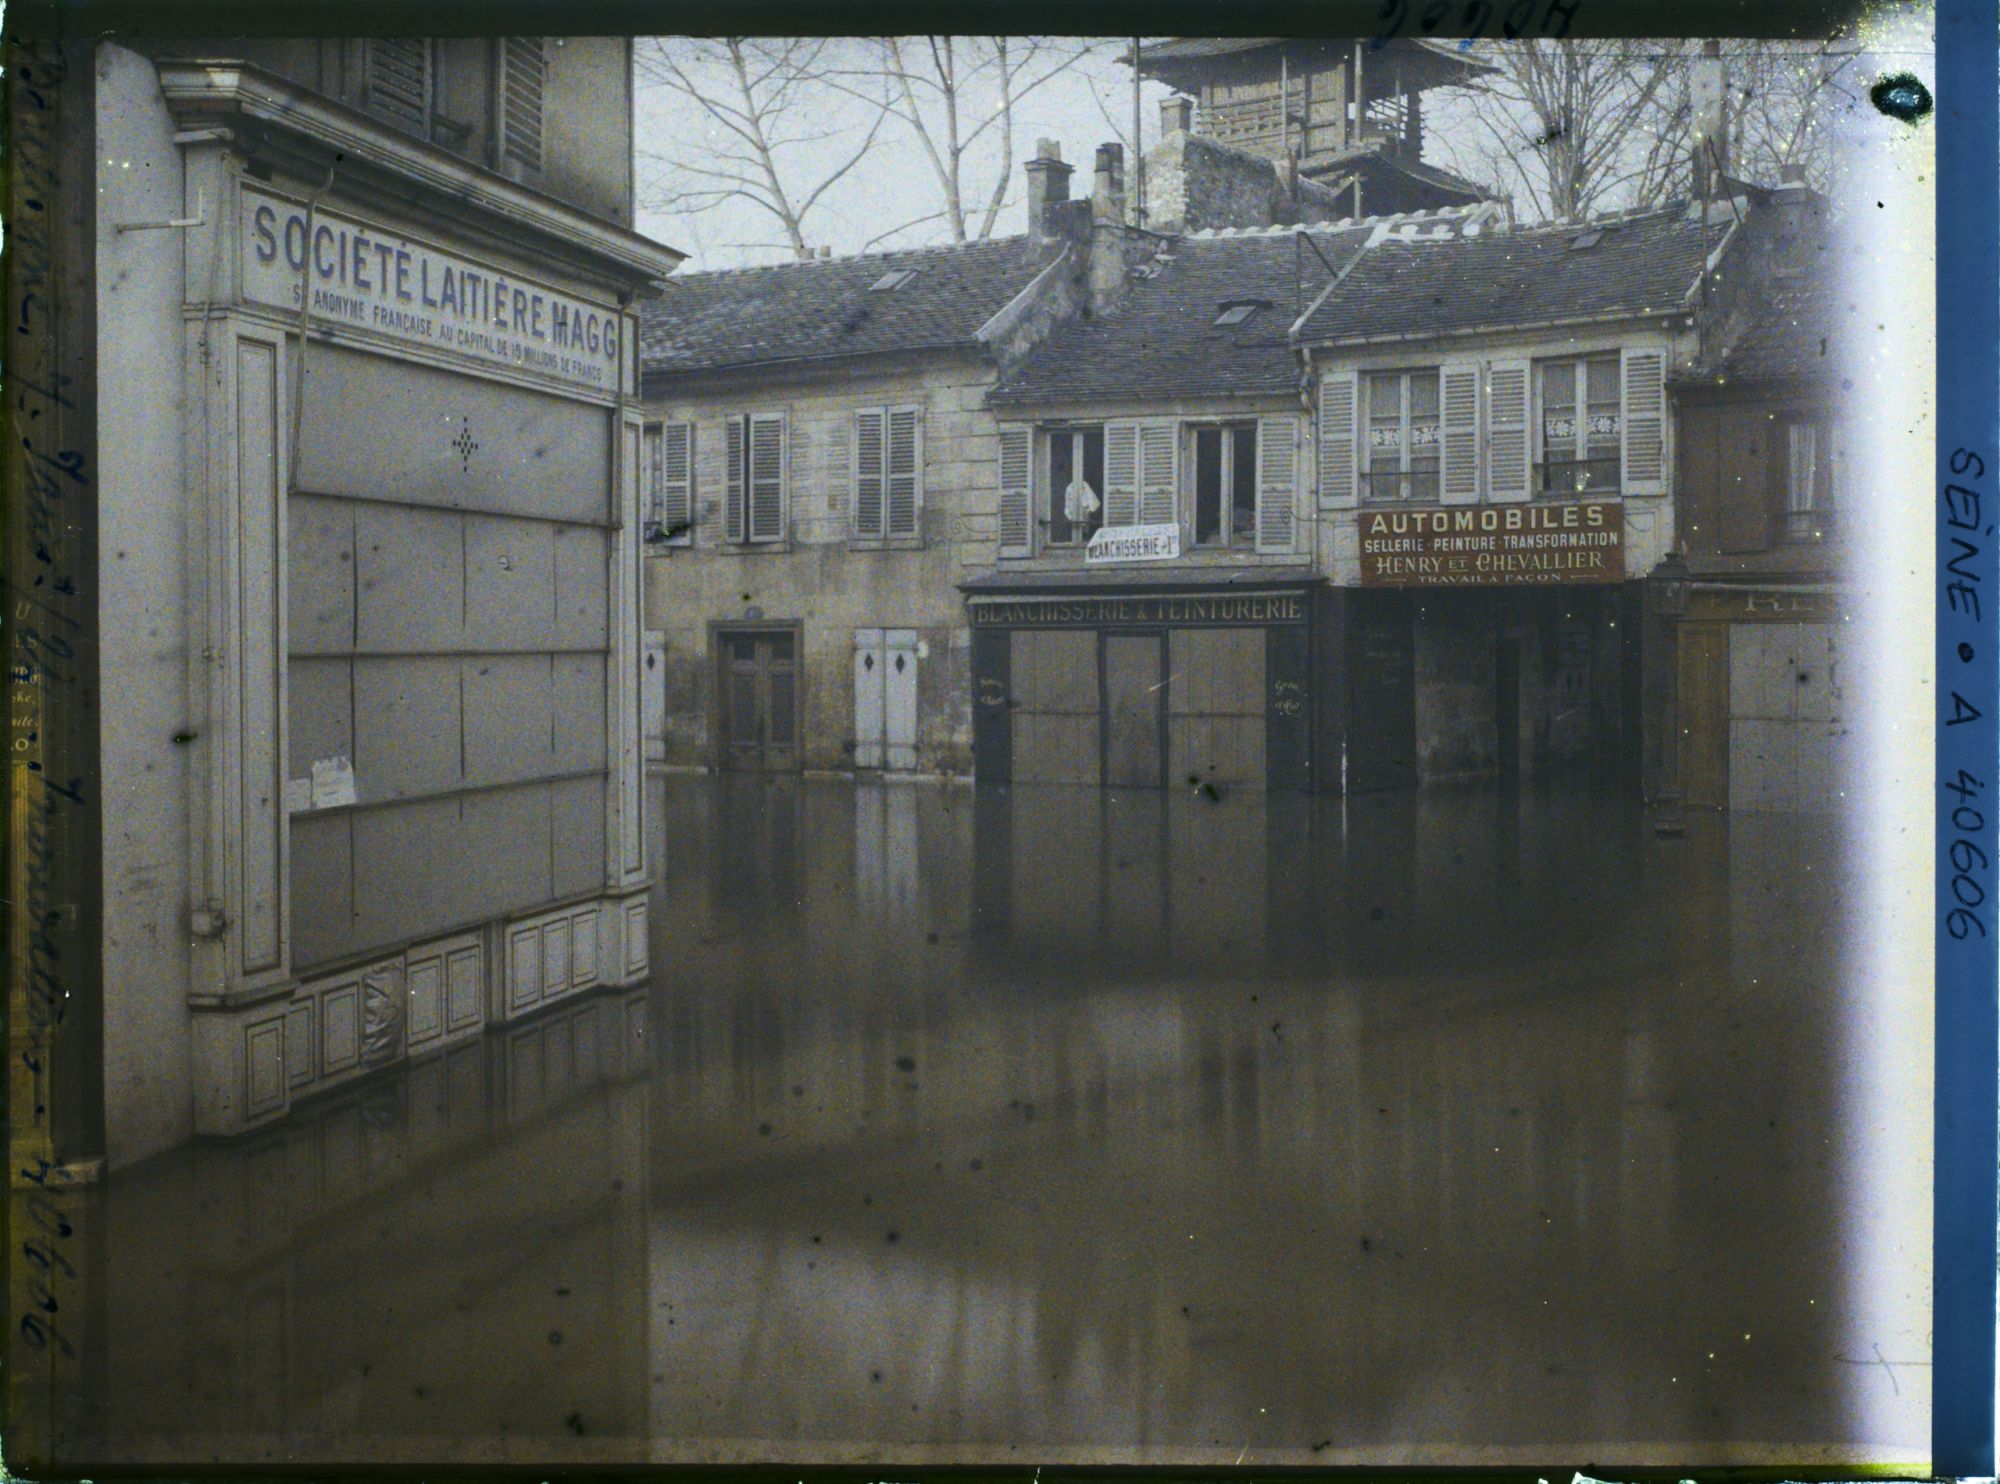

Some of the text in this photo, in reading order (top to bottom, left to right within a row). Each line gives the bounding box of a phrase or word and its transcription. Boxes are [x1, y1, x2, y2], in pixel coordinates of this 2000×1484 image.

[313, 289, 366, 321] ANONYME
[439, 323, 454, 342] AU
[457, 328, 495, 354] CAPITAL
[551, 301, 622, 361] MAGG
[1370, 506, 1604, 534] AUTOMOBILES
[1364, 532, 1618, 553] SELLERIE PEINTURE TRANSFORMATION
[1376, 551, 1606, 574] HENRY ET CHEVALLIER
[1419, 575, 1485, 584] TRAVAIL
[977, 599, 1302, 622] BLANCHISSERIE & TEINTURERIE
[1944, 690, 1983, 727] A
[1944, 768, 1989, 942] 40606
